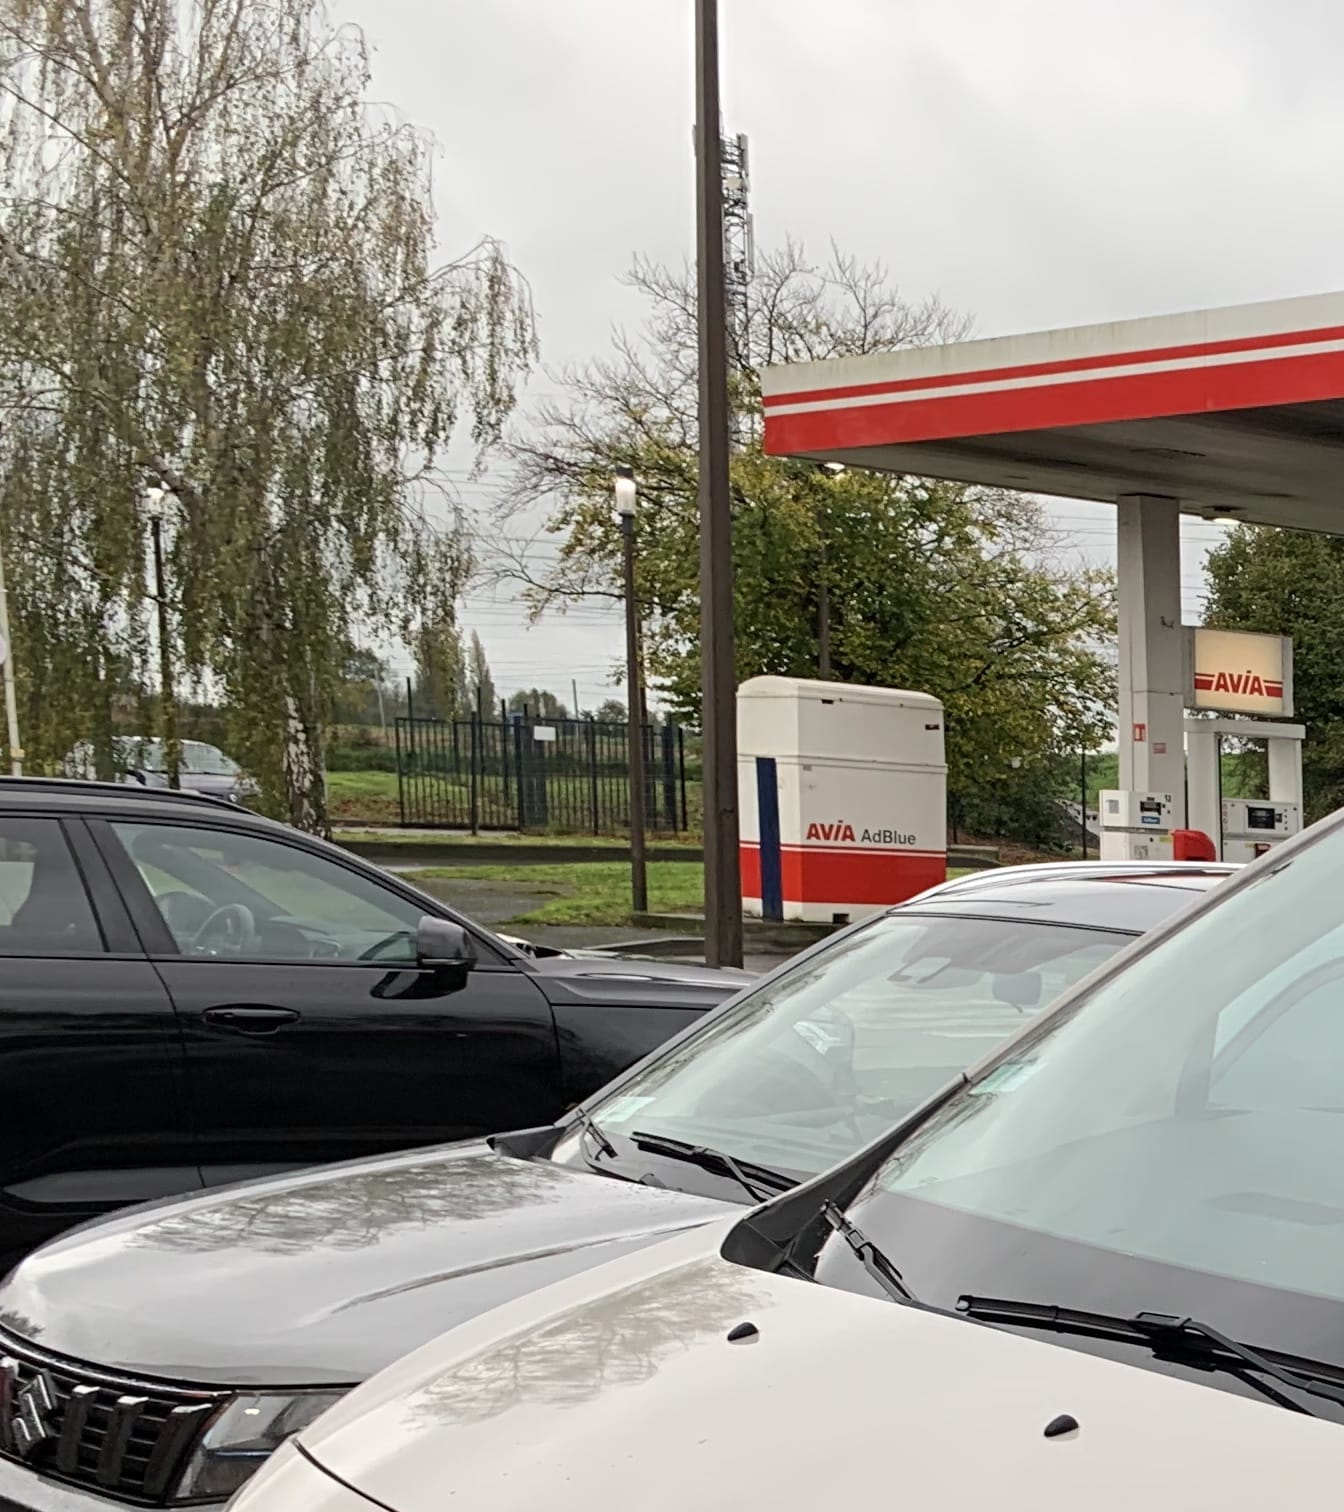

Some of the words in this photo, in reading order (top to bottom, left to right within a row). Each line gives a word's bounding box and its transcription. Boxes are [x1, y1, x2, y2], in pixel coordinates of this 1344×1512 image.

[1214, 669, 1264, 697] AVIA
[806, 819, 857, 842] AVIA
[861, 828, 917, 845] AdBlue
